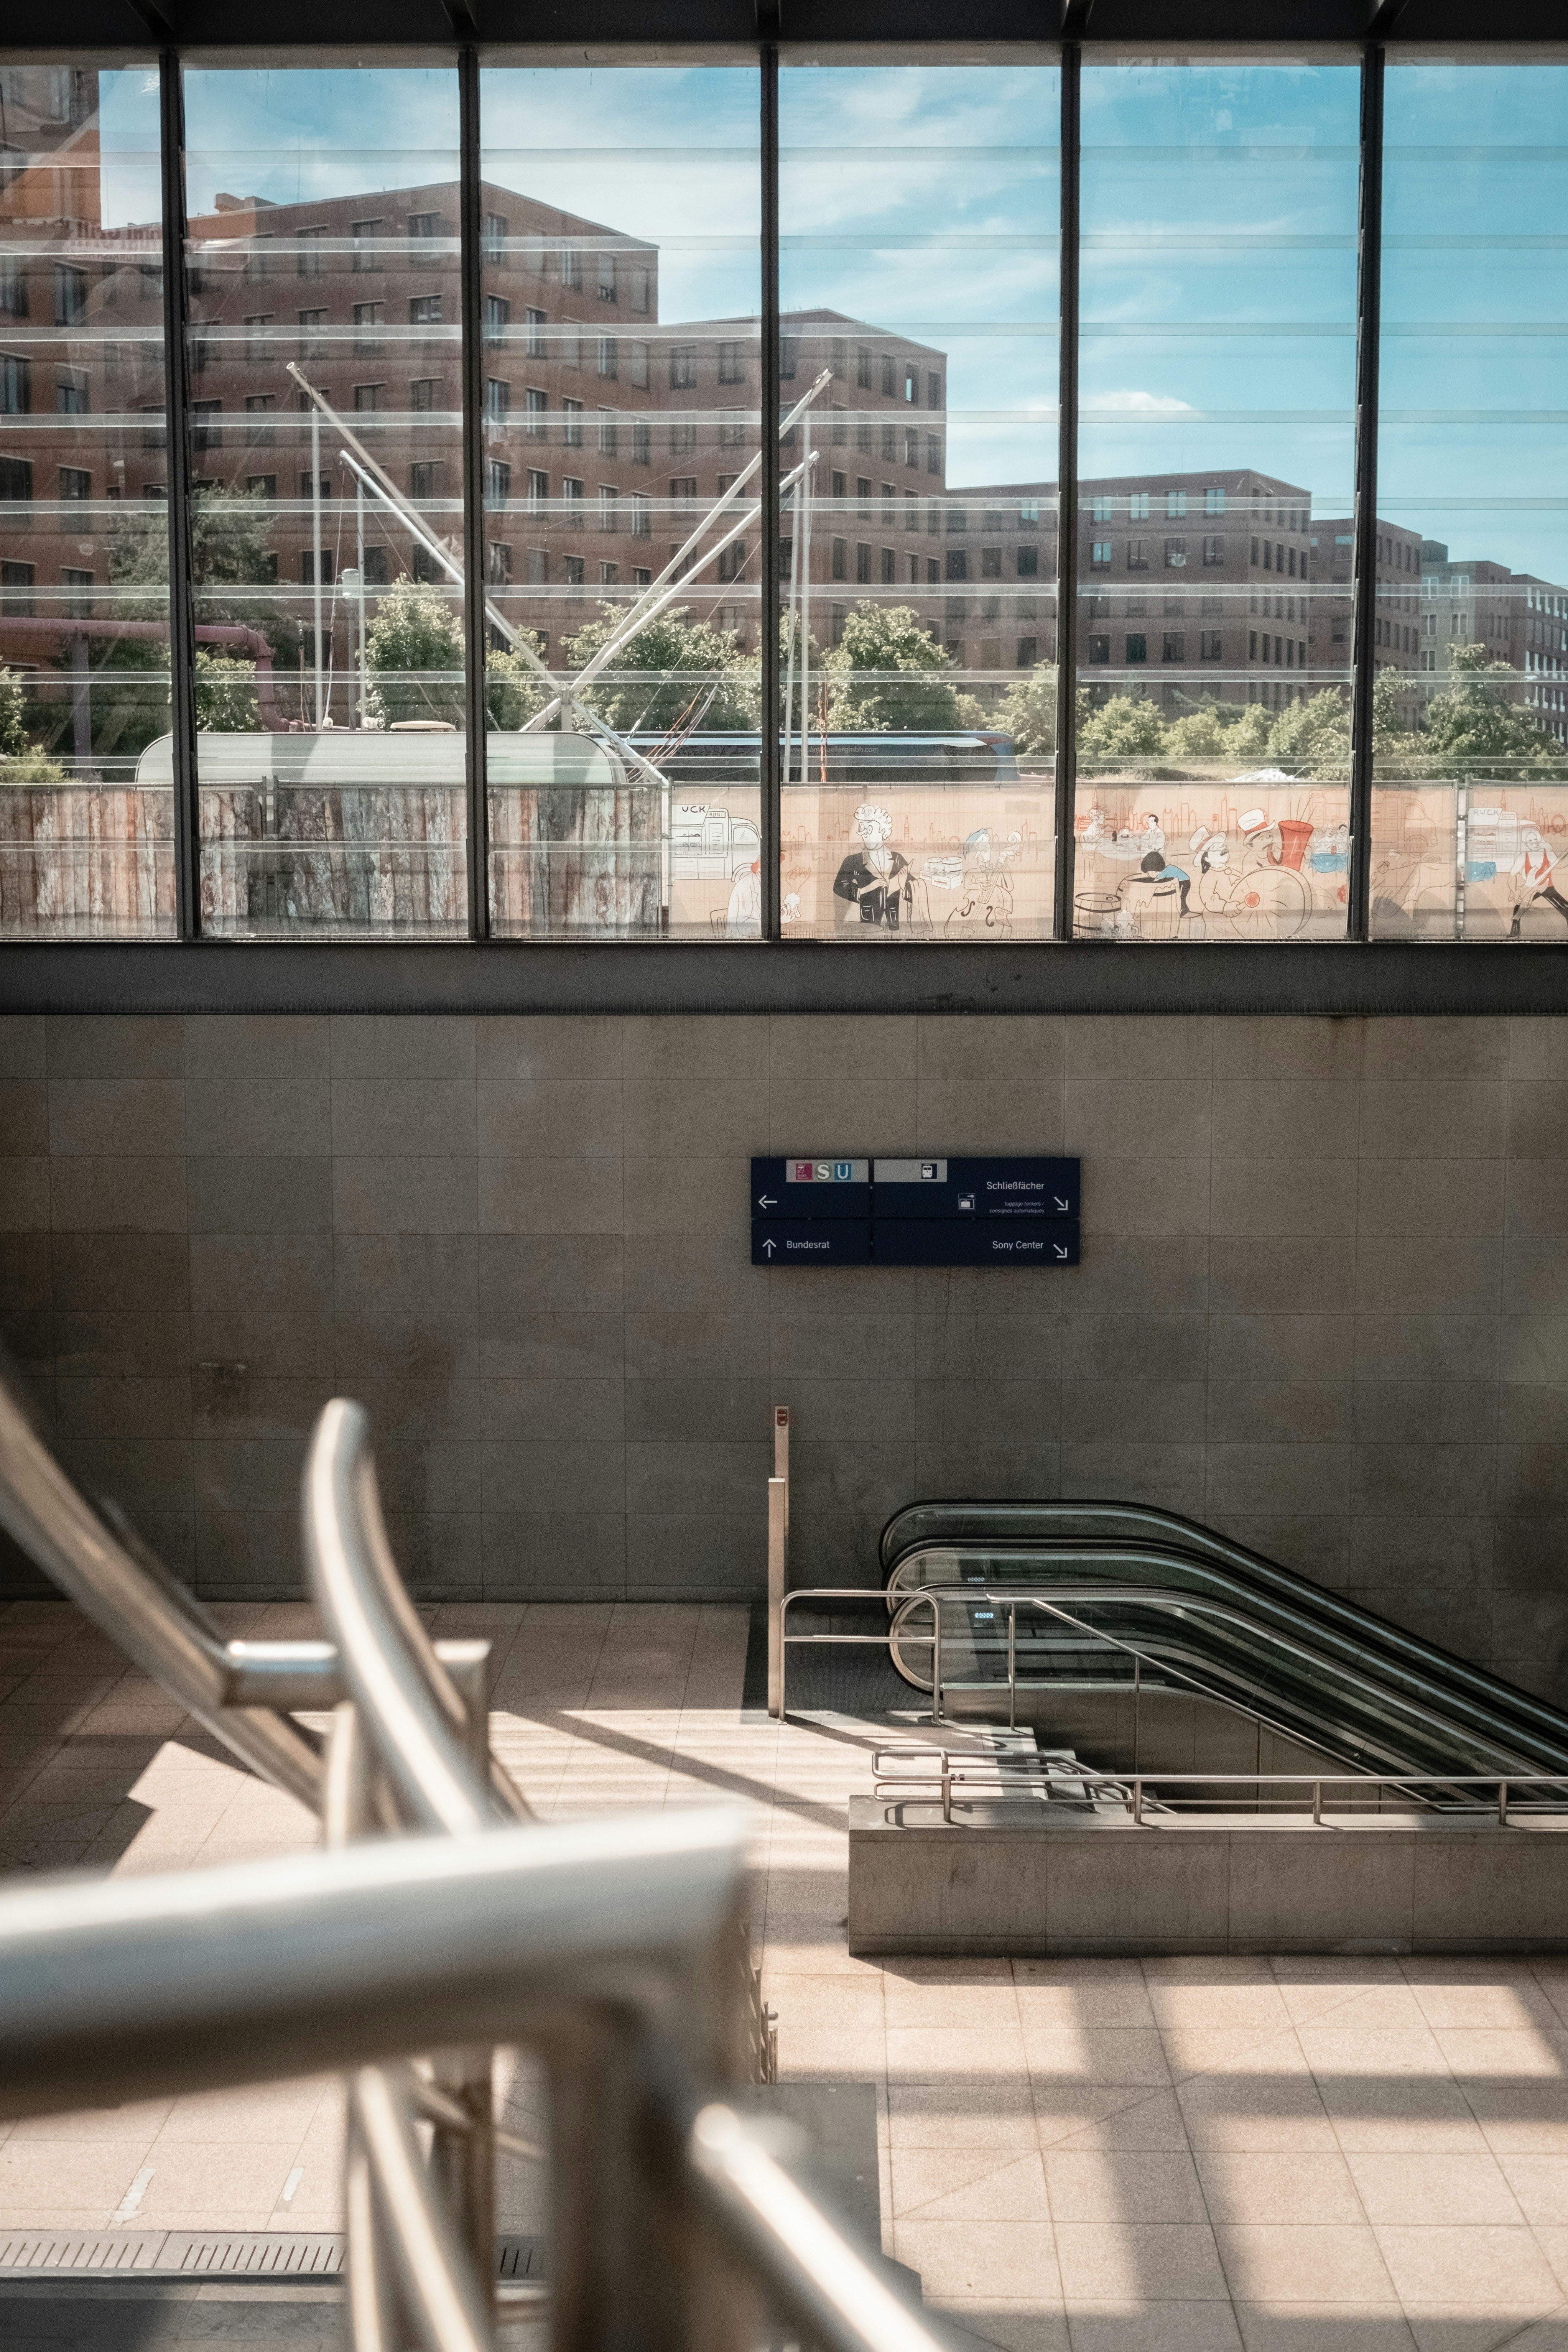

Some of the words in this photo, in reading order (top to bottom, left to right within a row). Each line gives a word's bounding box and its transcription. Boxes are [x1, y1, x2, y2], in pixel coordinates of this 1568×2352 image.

[817, 1164, 830, 1179] S
[837, 1164, 849, 1179] U
[987, 1181, 1045, 1190] Schließfächer
[786, 1240, 830, 1249] Bundesrat
[992, 1240, 1014, 1251] Sony
[1016, 1240, 1044, 1249] Center
